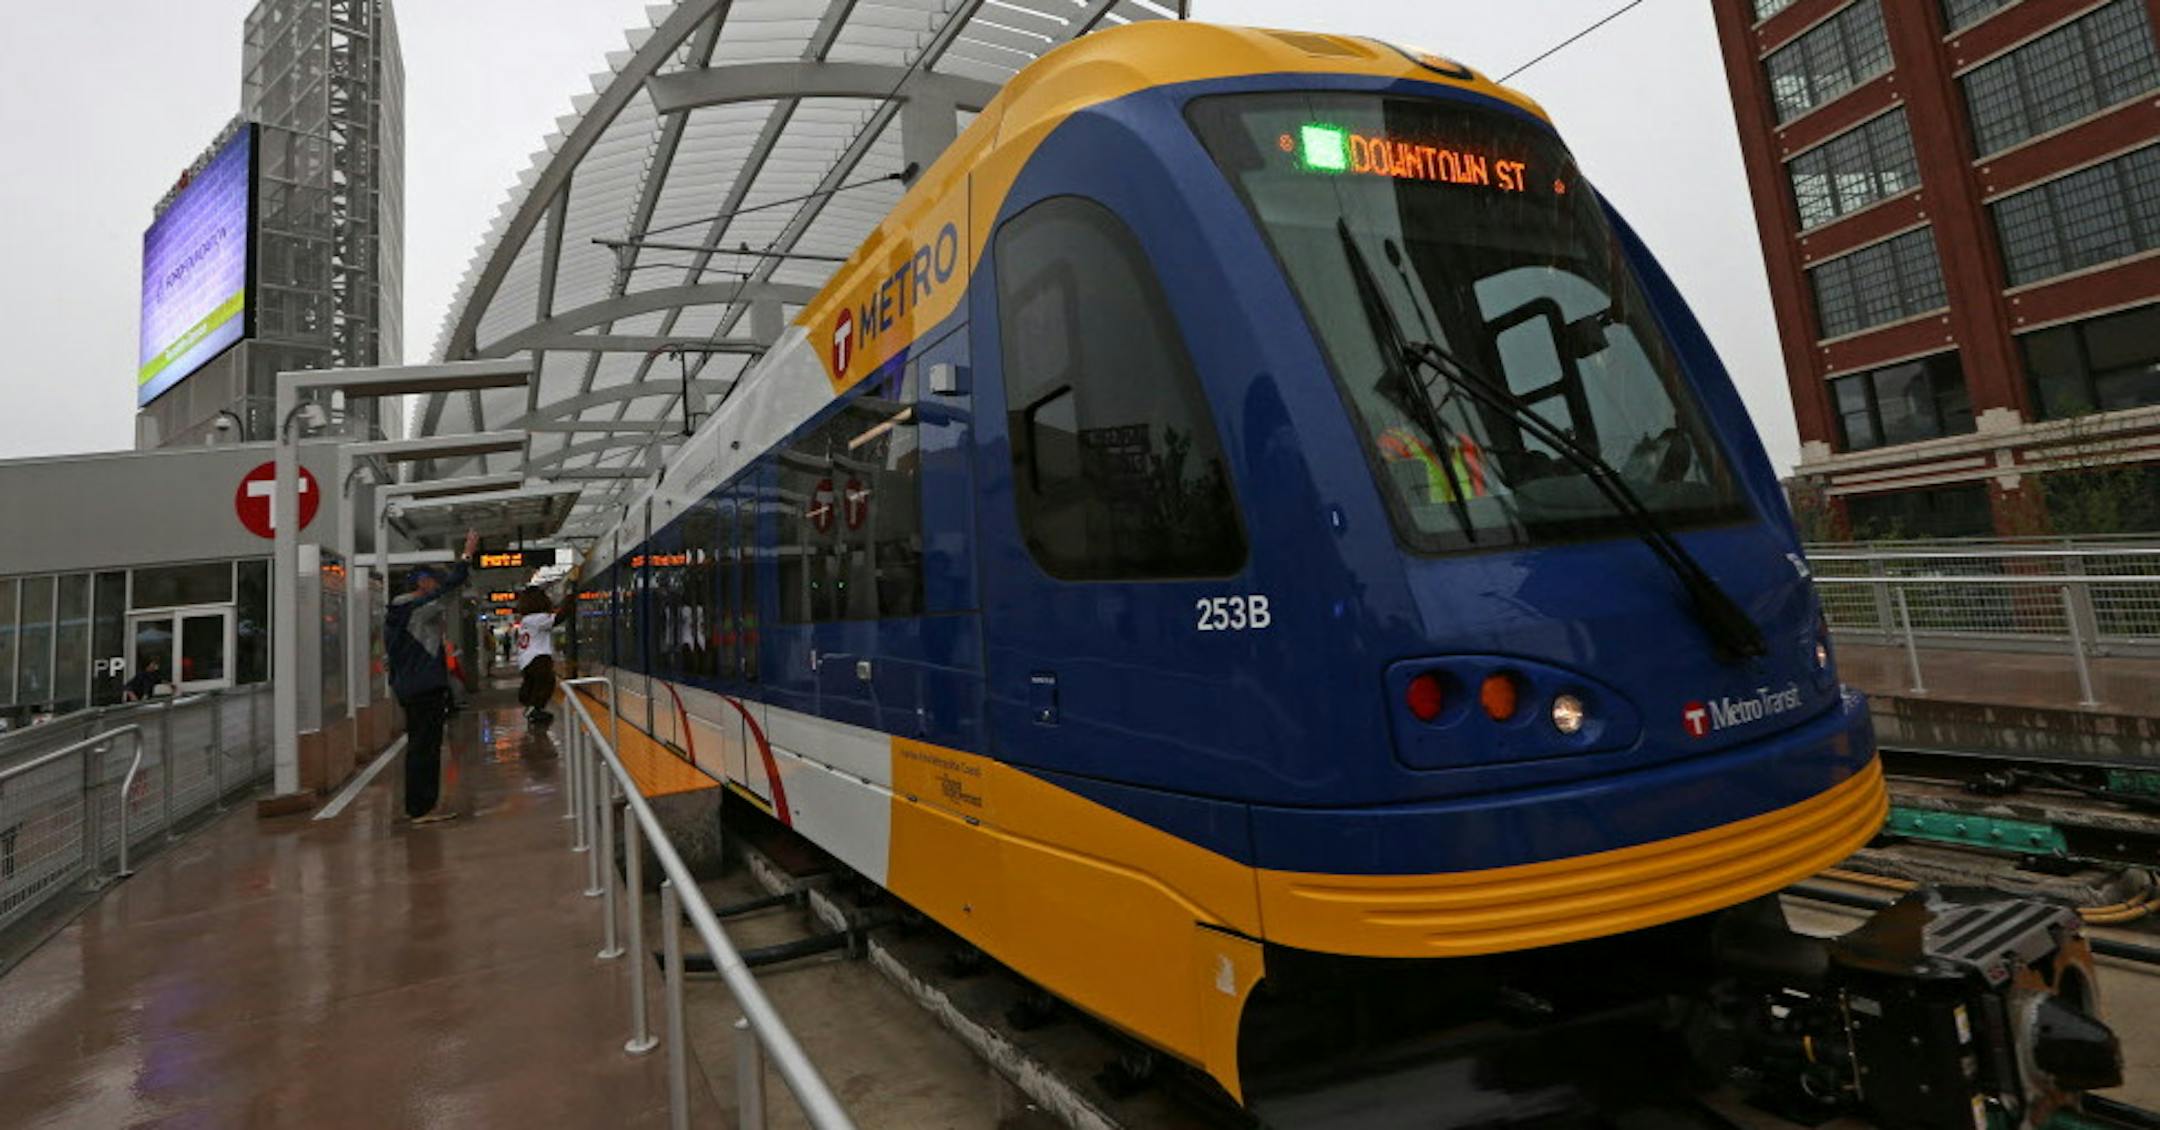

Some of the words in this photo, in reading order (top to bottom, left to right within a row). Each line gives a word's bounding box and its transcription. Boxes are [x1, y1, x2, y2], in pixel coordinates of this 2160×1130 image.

[1349, 134, 1489, 185] DOWNTOWN
[1495, 159, 1526, 193] ST
[859, 221, 958, 351] METRO
[1196, 594, 1272, 631] 253B
[1684, 708, 1706, 735] T
[1707, 696, 1763, 731] Metro
